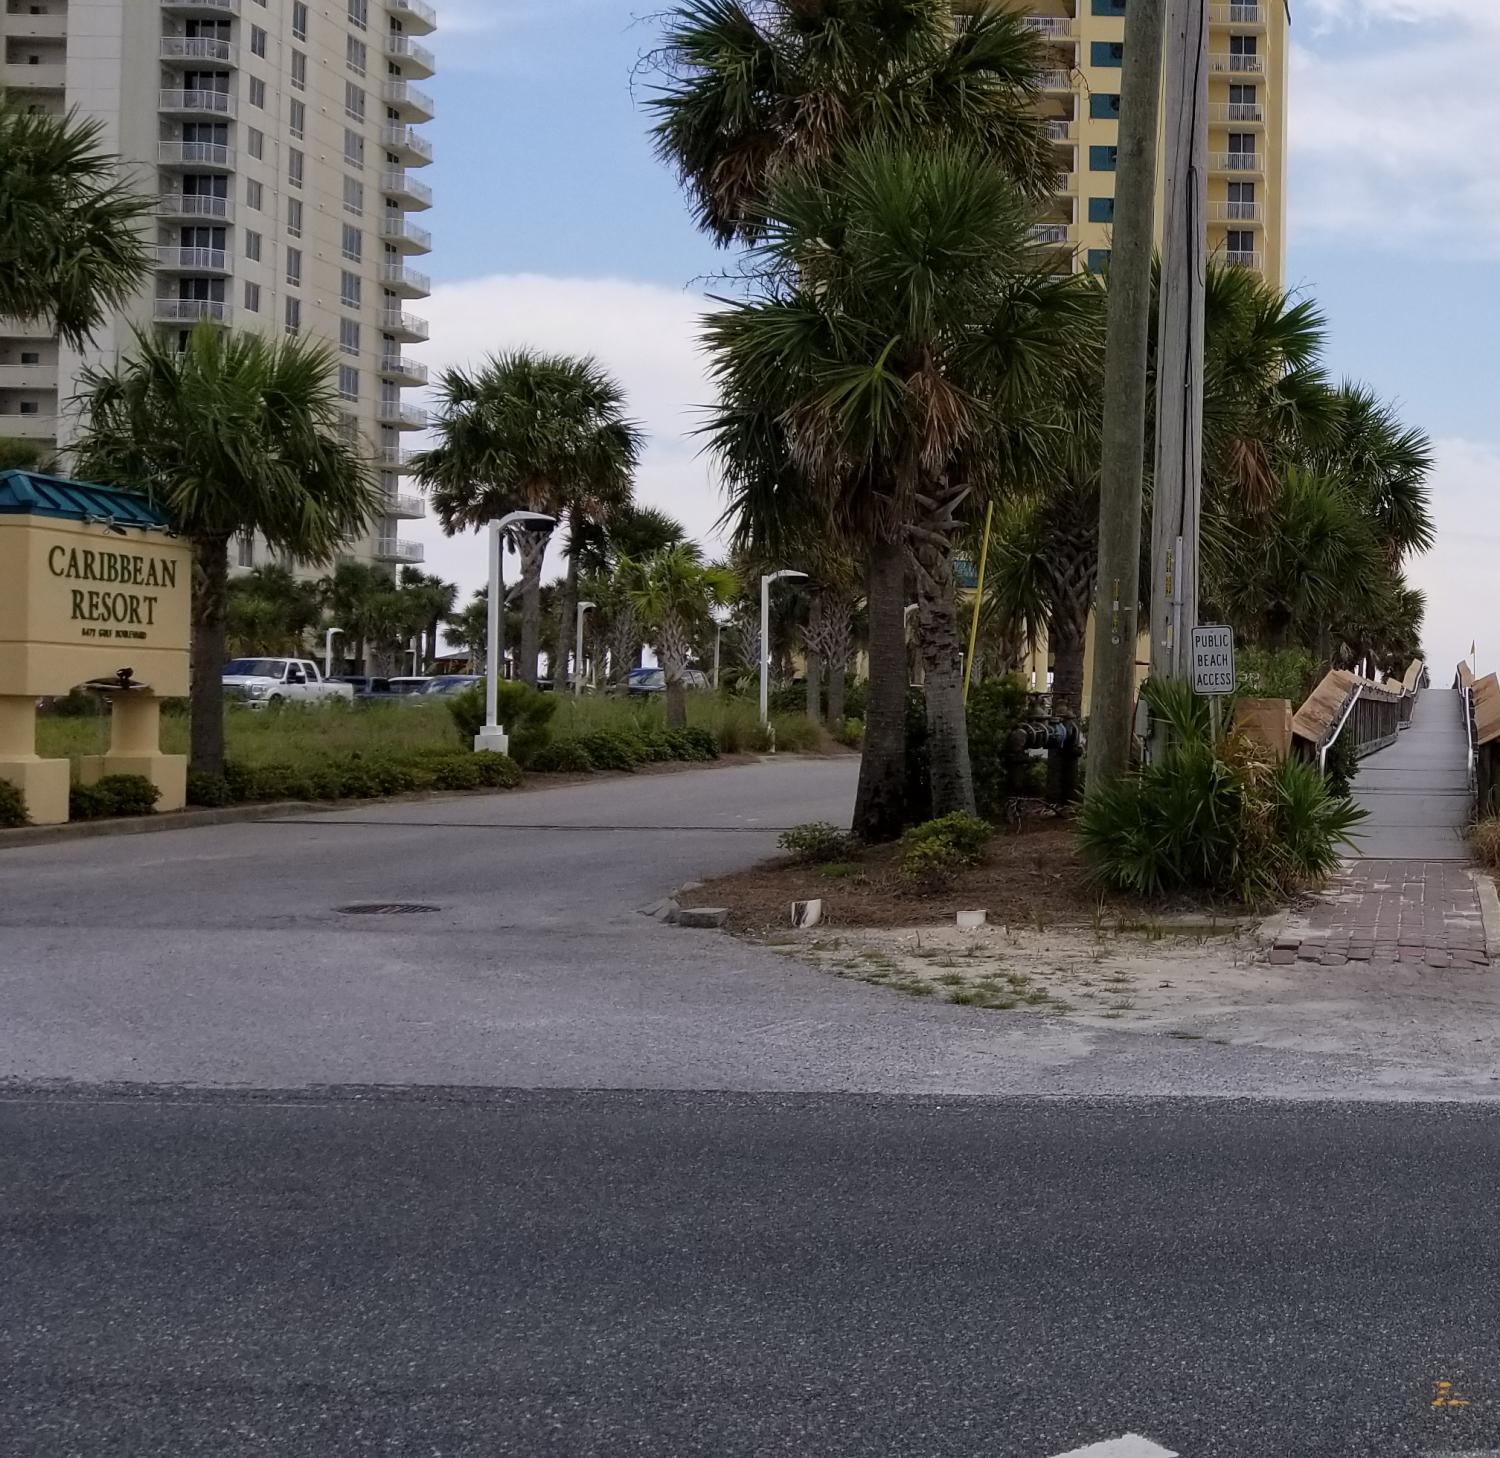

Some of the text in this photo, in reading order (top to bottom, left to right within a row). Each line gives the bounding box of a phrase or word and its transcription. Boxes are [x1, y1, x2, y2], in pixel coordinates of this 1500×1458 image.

[48, 545, 177, 588] CARIBBEAN
[71, 589, 158, 625] RESORT
[1195, 634, 1229, 648] PUBLIC
[1197, 654, 1228, 667] BEACH
[1197, 673, 1231, 686] ACCESS
